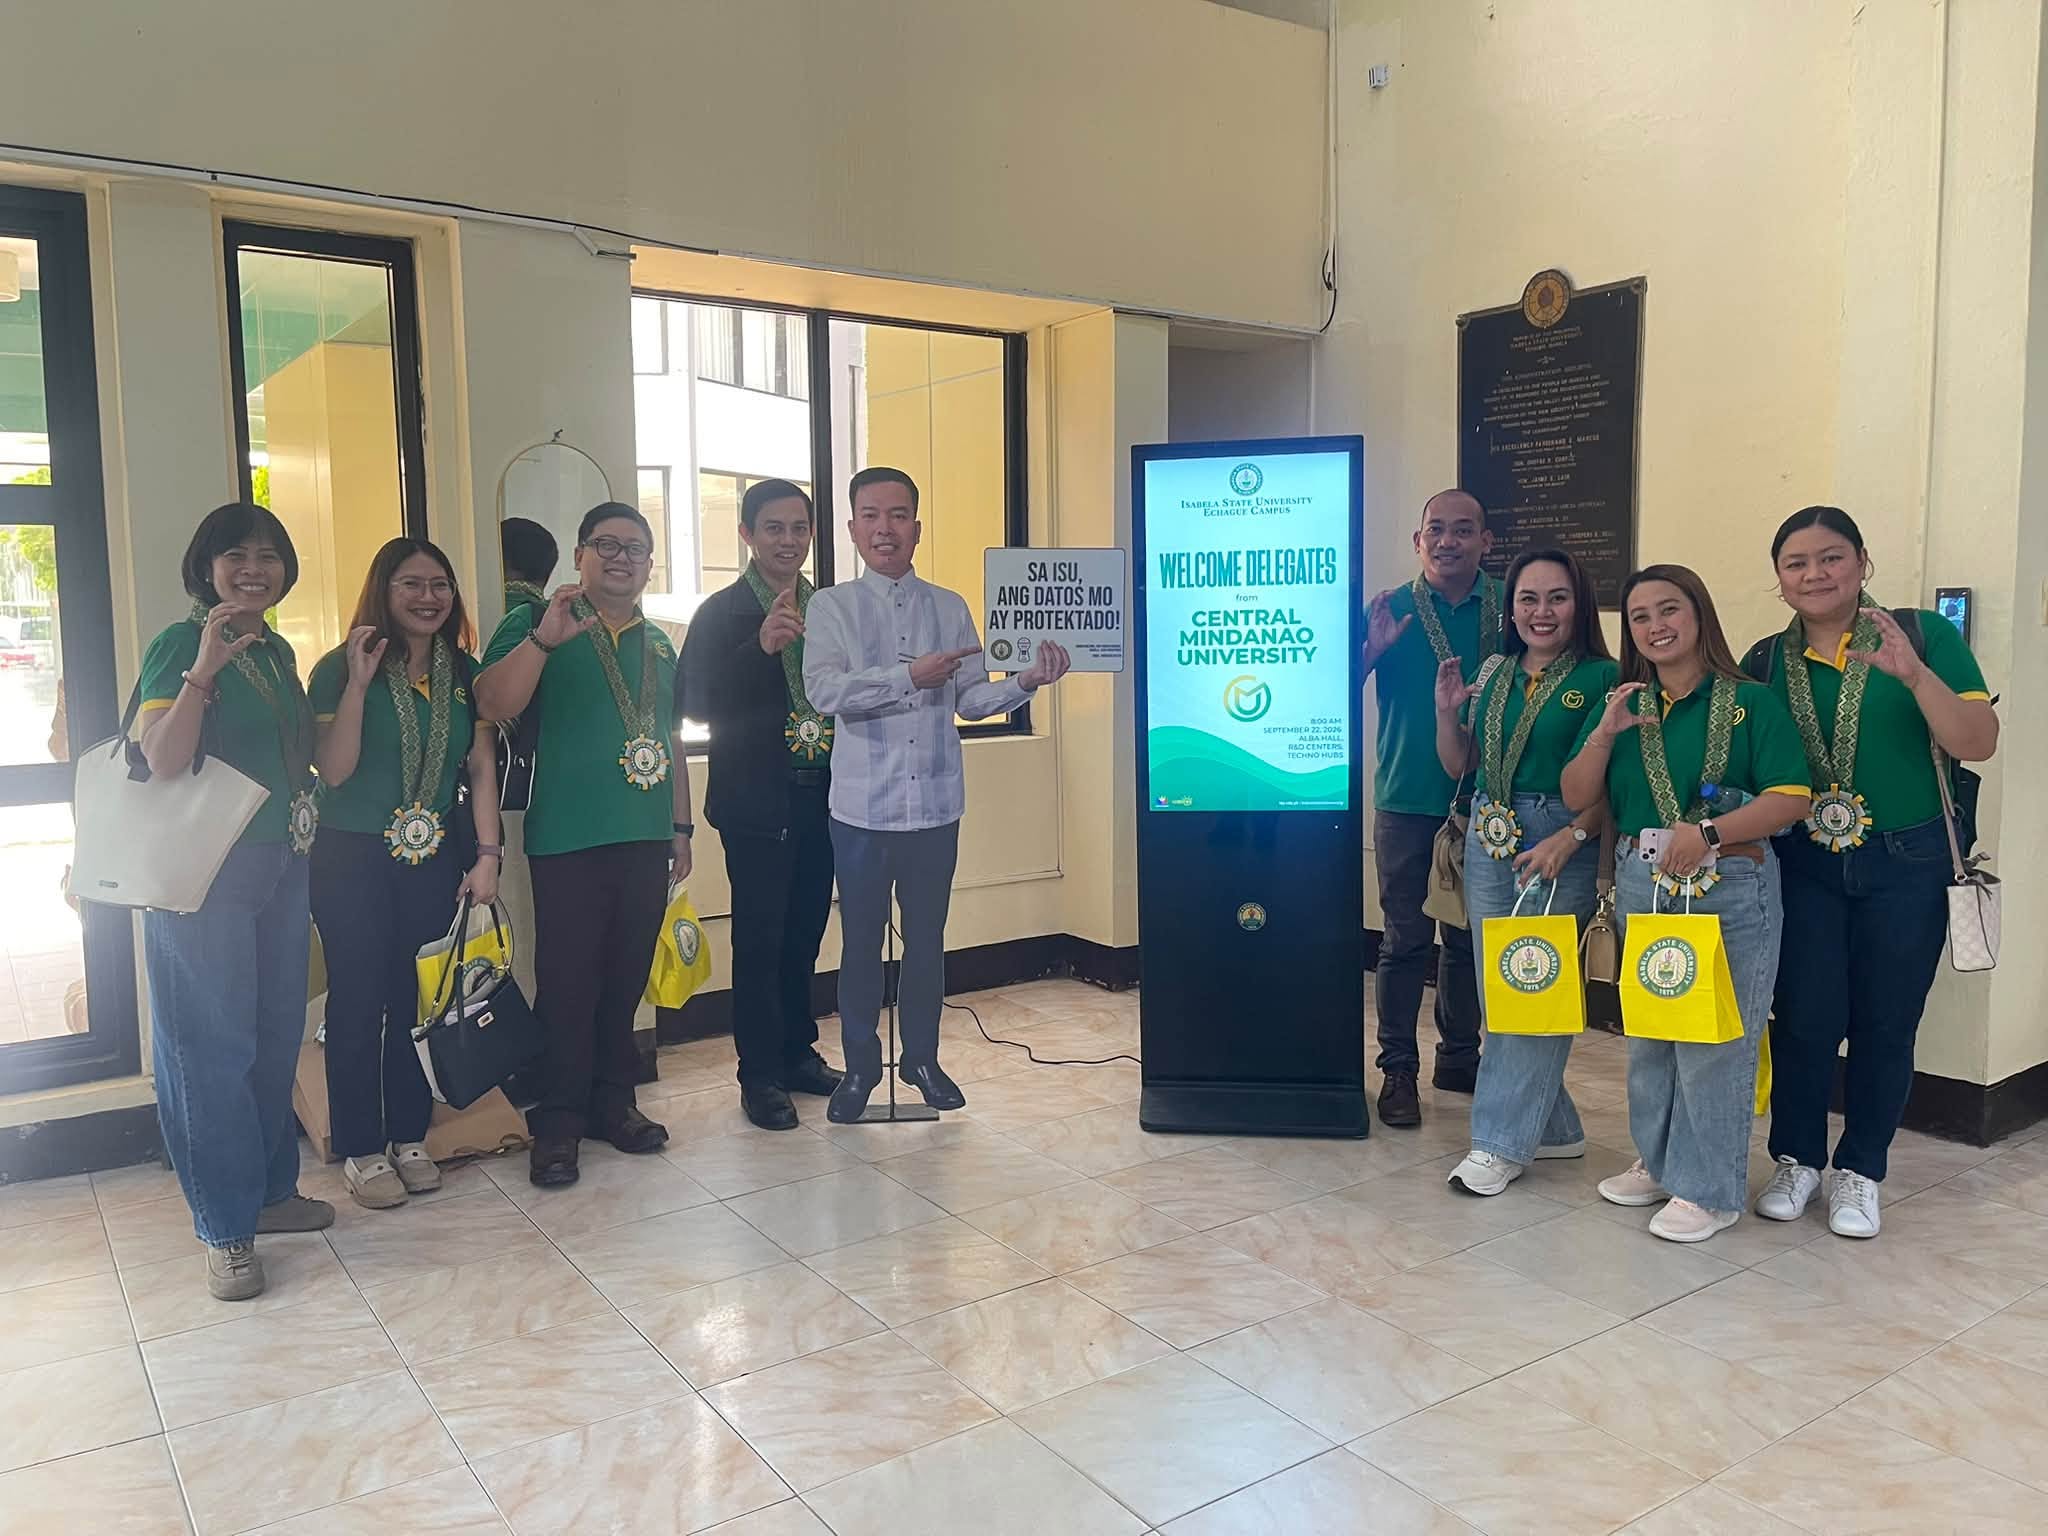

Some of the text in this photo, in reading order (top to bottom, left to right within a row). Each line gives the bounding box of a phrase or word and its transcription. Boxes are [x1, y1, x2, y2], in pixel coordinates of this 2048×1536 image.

[1181, 497, 1313, 508] ISABELA STATE UNIVERSITY
[1250, 506, 1291, 515] CAMPUS
[1028, 562, 1083, 584] SA ISU,
[1159, 547, 1337, 589] WELCOME DELEGATES
[997, 586, 1113, 606] ANG DATOS MO
[1235, 593, 1258, 602] from
[989, 610, 1120, 630] AY PROTEKTADO!
[1191, 608, 1302, 627] CENTRAL
[1180, 627, 1314, 647] MINDANAO
[1177, 646, 1318, 666] UNIVERSITY
[1510, 938, 1535, 951] STATE
[1535, 940, 1559, 981] UNIVERSITY
[1652, 939, 1676, 951] STATE
[1677, 941, 1695, 985] UNIVERSITY
